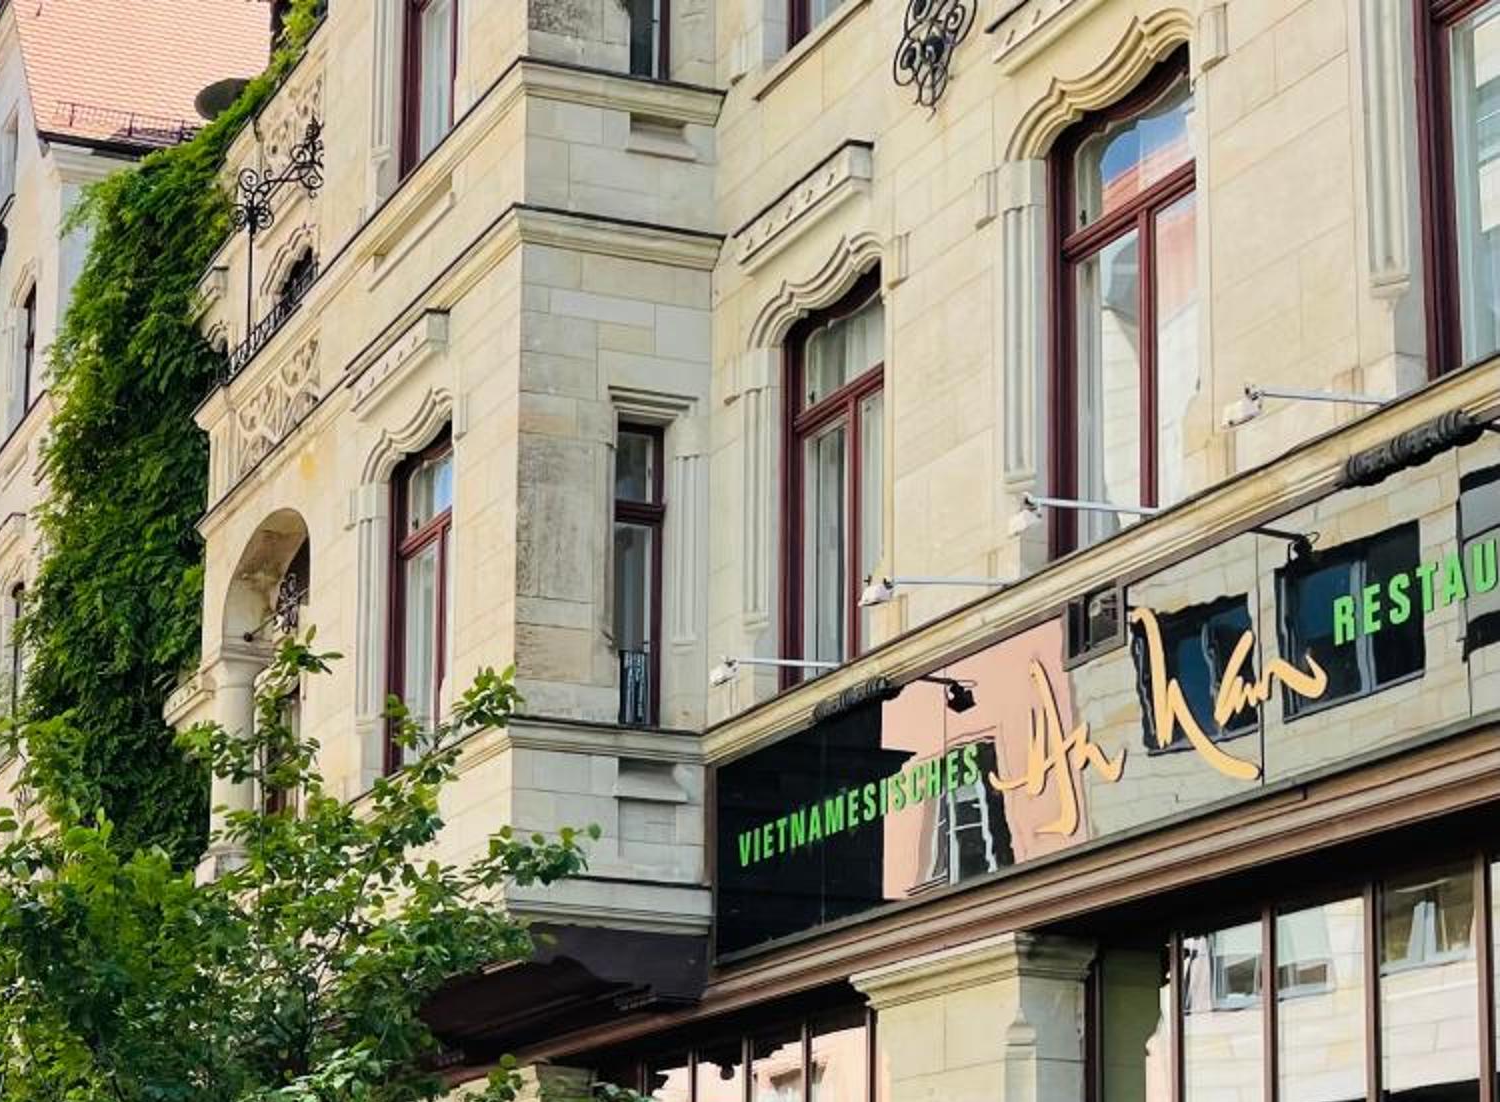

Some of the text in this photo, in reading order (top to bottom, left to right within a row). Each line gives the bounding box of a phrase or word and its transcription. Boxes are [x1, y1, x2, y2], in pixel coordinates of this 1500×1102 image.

[738, 744, 979, 868] VIETNAMESISCHES
[988, 656, 1128, 836] An
[1333, 538, 1497, 646] RESTAU
